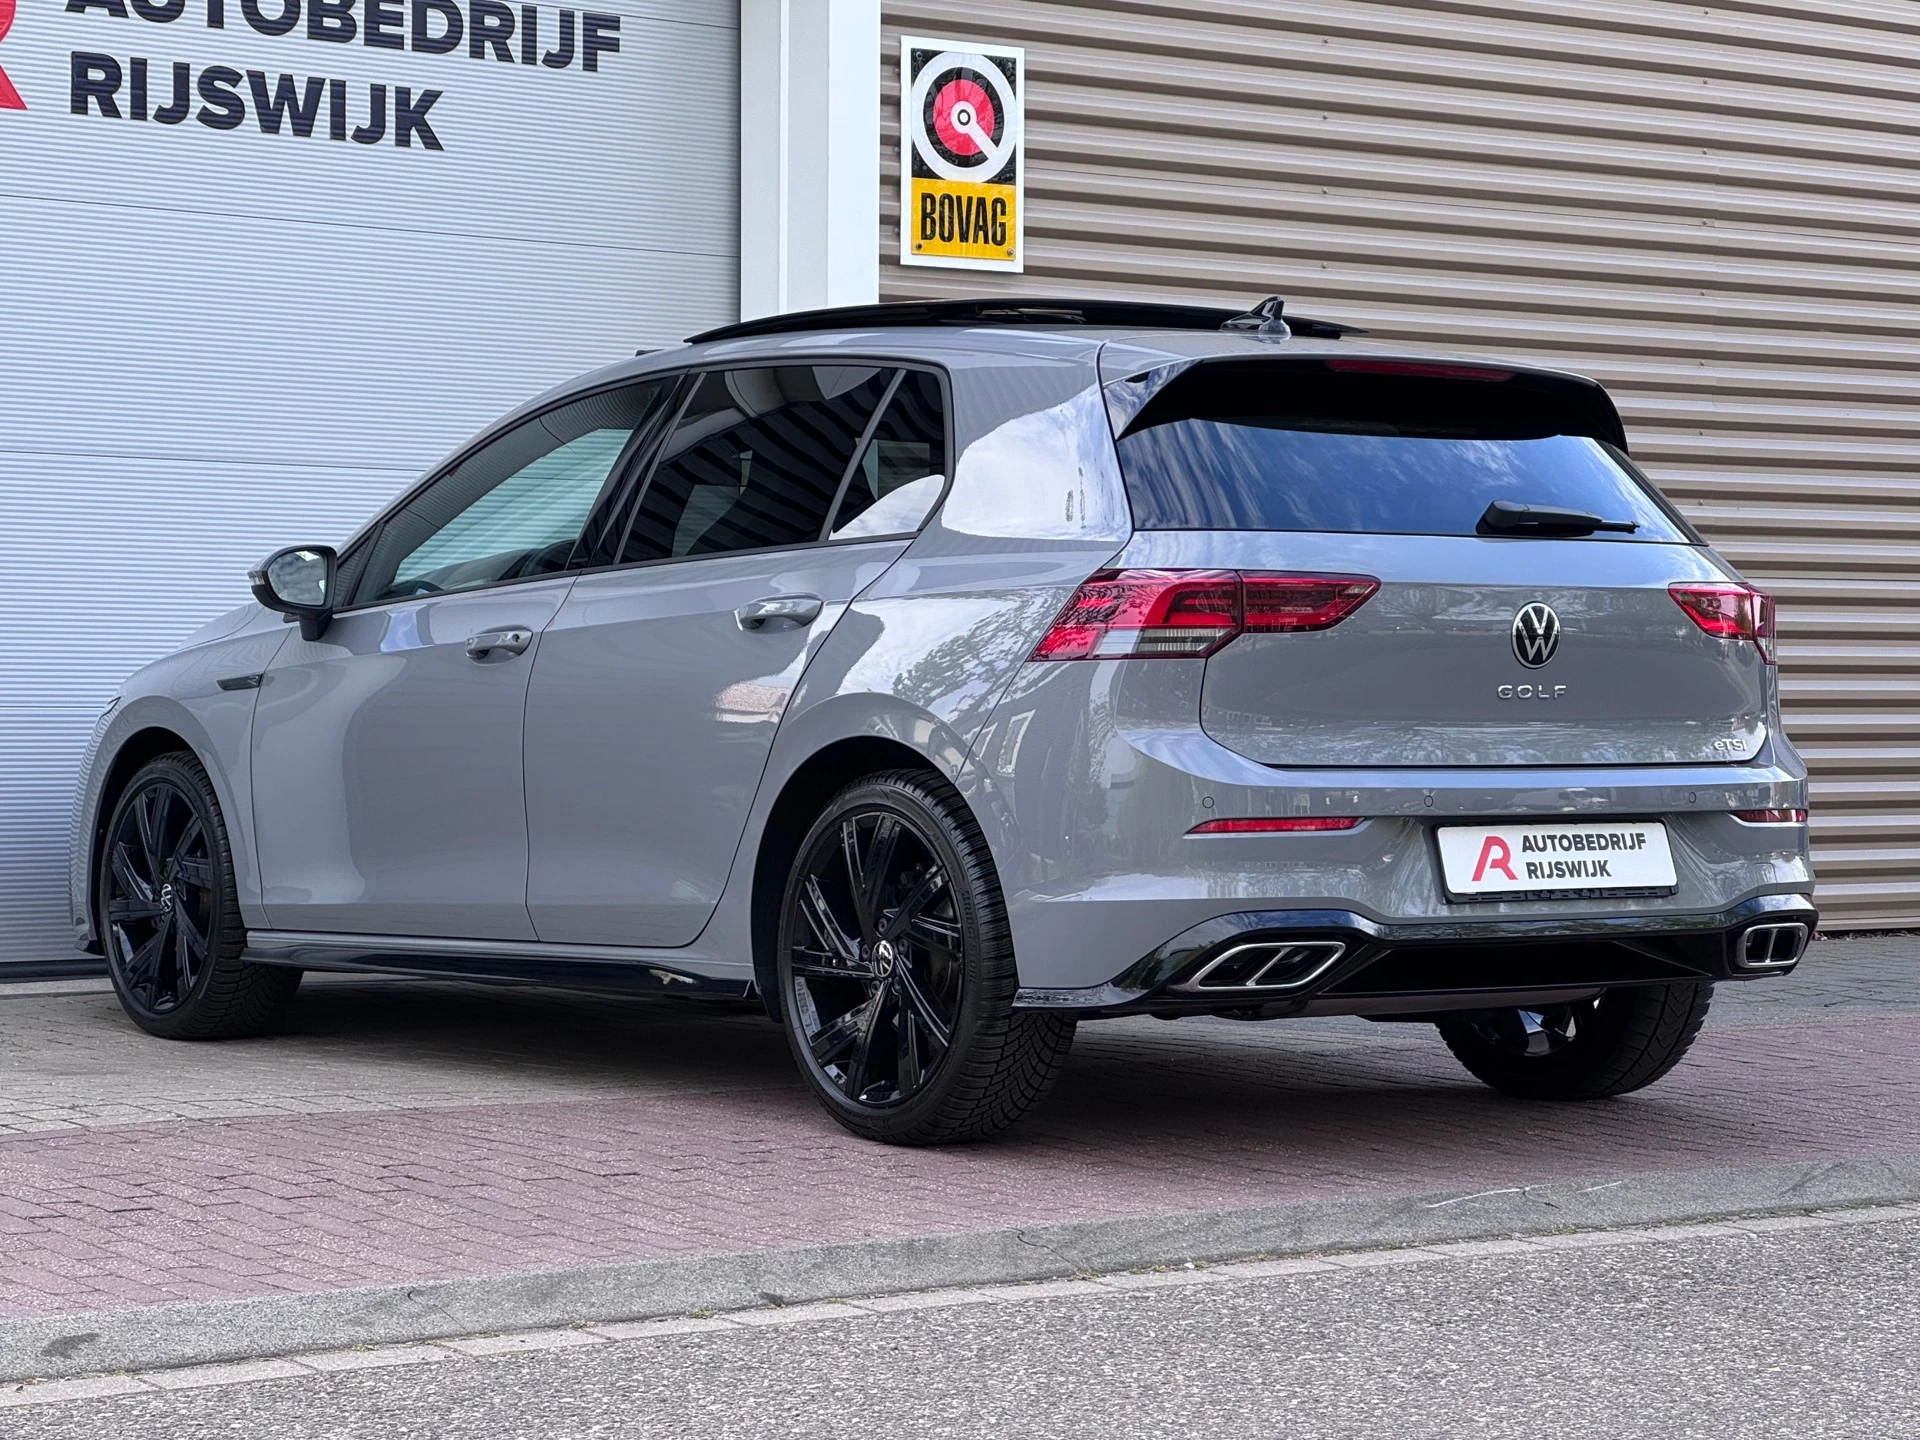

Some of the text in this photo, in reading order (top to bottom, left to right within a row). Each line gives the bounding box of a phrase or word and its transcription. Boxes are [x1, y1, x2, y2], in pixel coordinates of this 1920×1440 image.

[70, 51, 444, 151] RIJSWIJK
[920, 192, 1007, 246] BOVAG
[1497, 684, 1567, 699] GOLF
[1714, 738, 1747, 751] eTSI
[1521, 833, 1647, 853] AUTOBEDRIJF
[1525, 860, 1612, 880] RIJSWIJK
